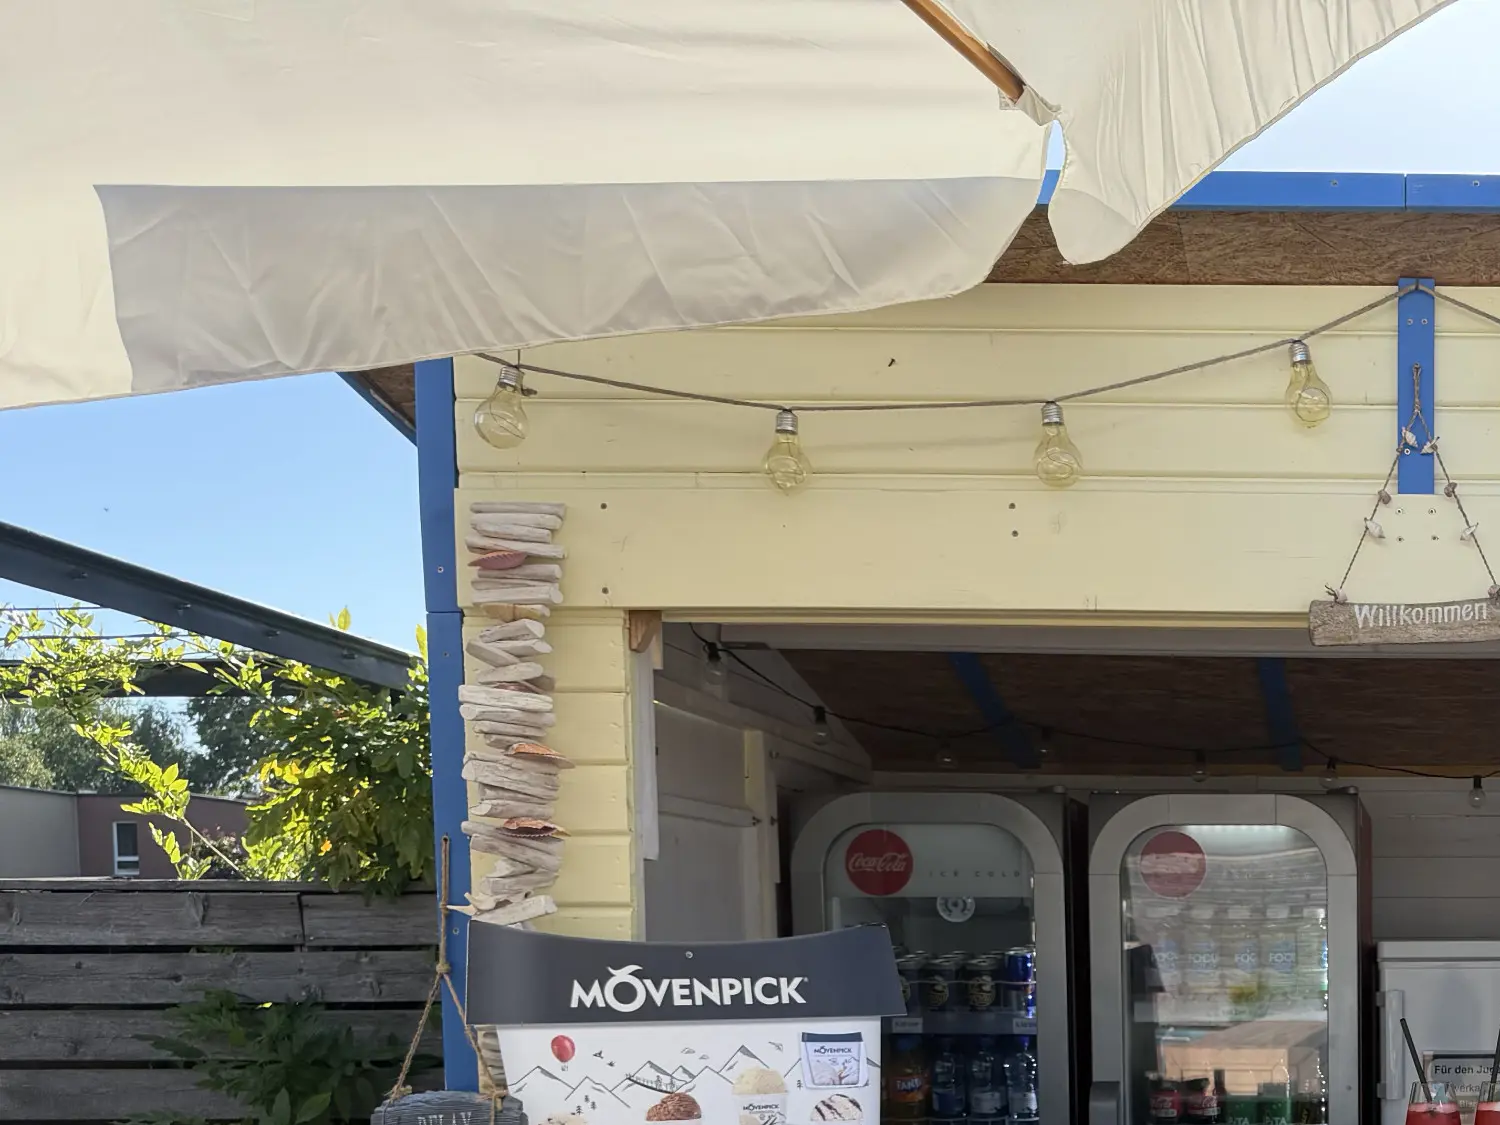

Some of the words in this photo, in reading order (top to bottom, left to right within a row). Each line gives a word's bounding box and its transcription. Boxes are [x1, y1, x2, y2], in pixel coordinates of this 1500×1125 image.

[1352, 602, 1487, 628] Willkommen
[1434, 1064, 1452, 1074] Für
[1455, 1064, 1473, 1074] den
